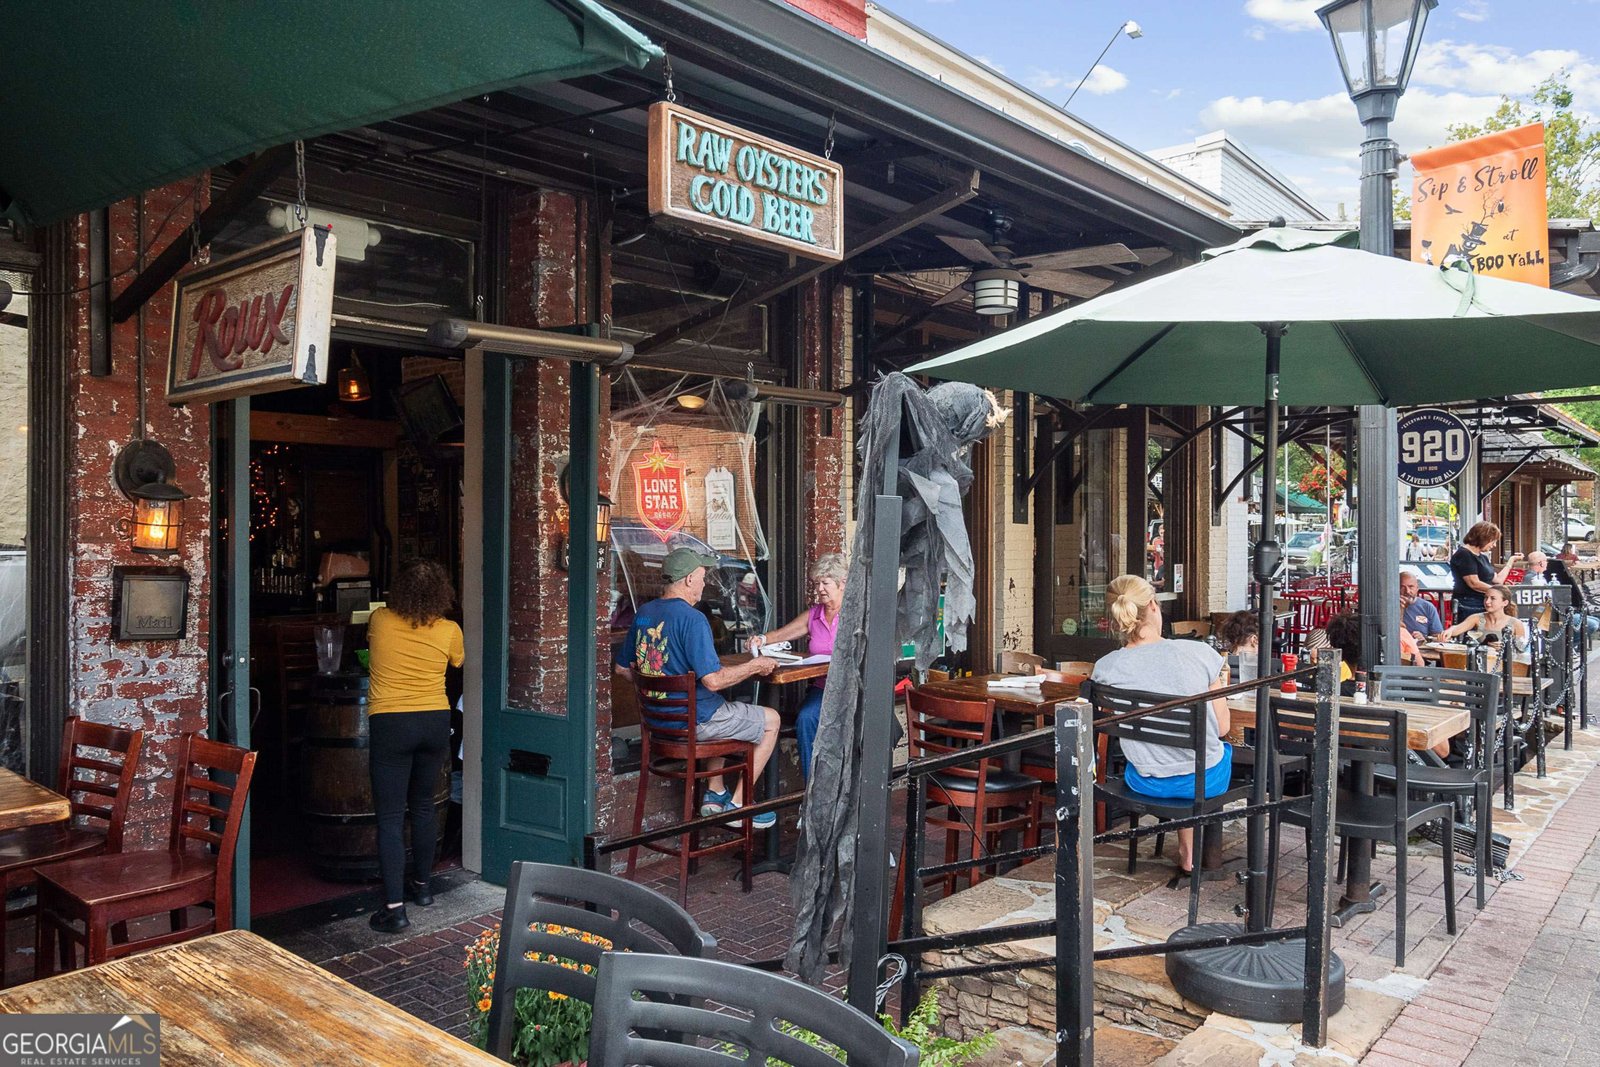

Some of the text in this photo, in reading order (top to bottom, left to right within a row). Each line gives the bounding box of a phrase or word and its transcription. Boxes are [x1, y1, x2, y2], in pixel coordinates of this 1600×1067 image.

[677, 121, 828, 206] RAW OYSTERS
[1418, 157, 1539, 203] Sip & Stroll
[689, 174, 817, 244] COLD BEER
[1502, 229, 1519, 241] at
[1476, 254, 1504, 273] BOO
[1406, 475, 1429, 485] TAVERN
[1430, 476, 1443, 484] FOR
[1443, 469, 1455, 479] ALL
[644, 479, 677, 493] LONE
[645, 495, 679, 509] STAR
[136, 616, 173, 629] Mail
